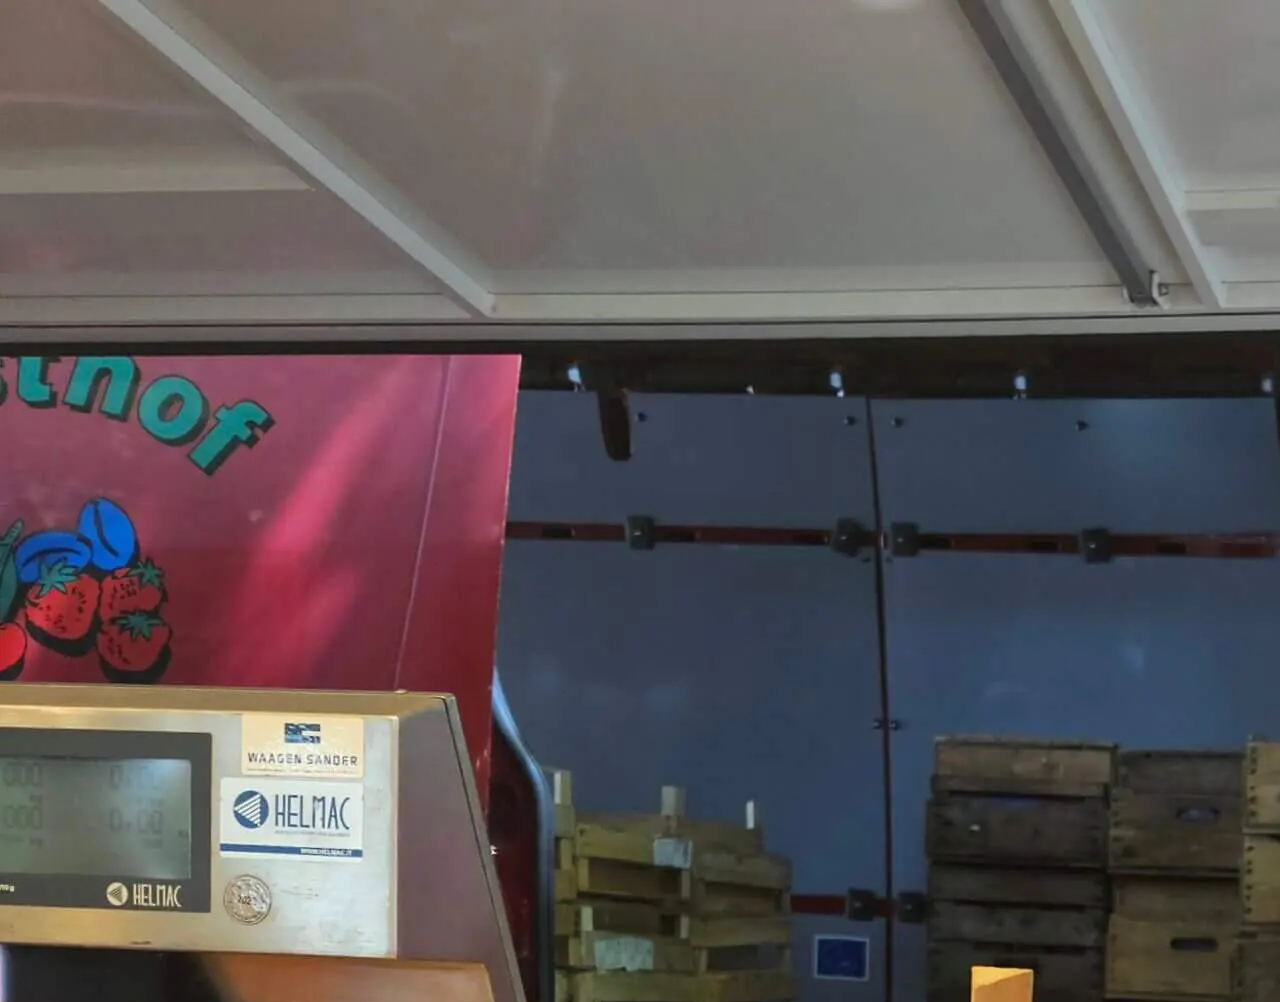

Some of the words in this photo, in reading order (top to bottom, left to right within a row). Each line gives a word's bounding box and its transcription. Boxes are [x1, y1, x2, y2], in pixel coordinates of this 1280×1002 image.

[247, 752, 301, 764] WAAGEN
[307, 754, 358, 767] SANDER
[274, 794, 350, 830] HELMAC
[132, 883, 182, 908] HELMAC
